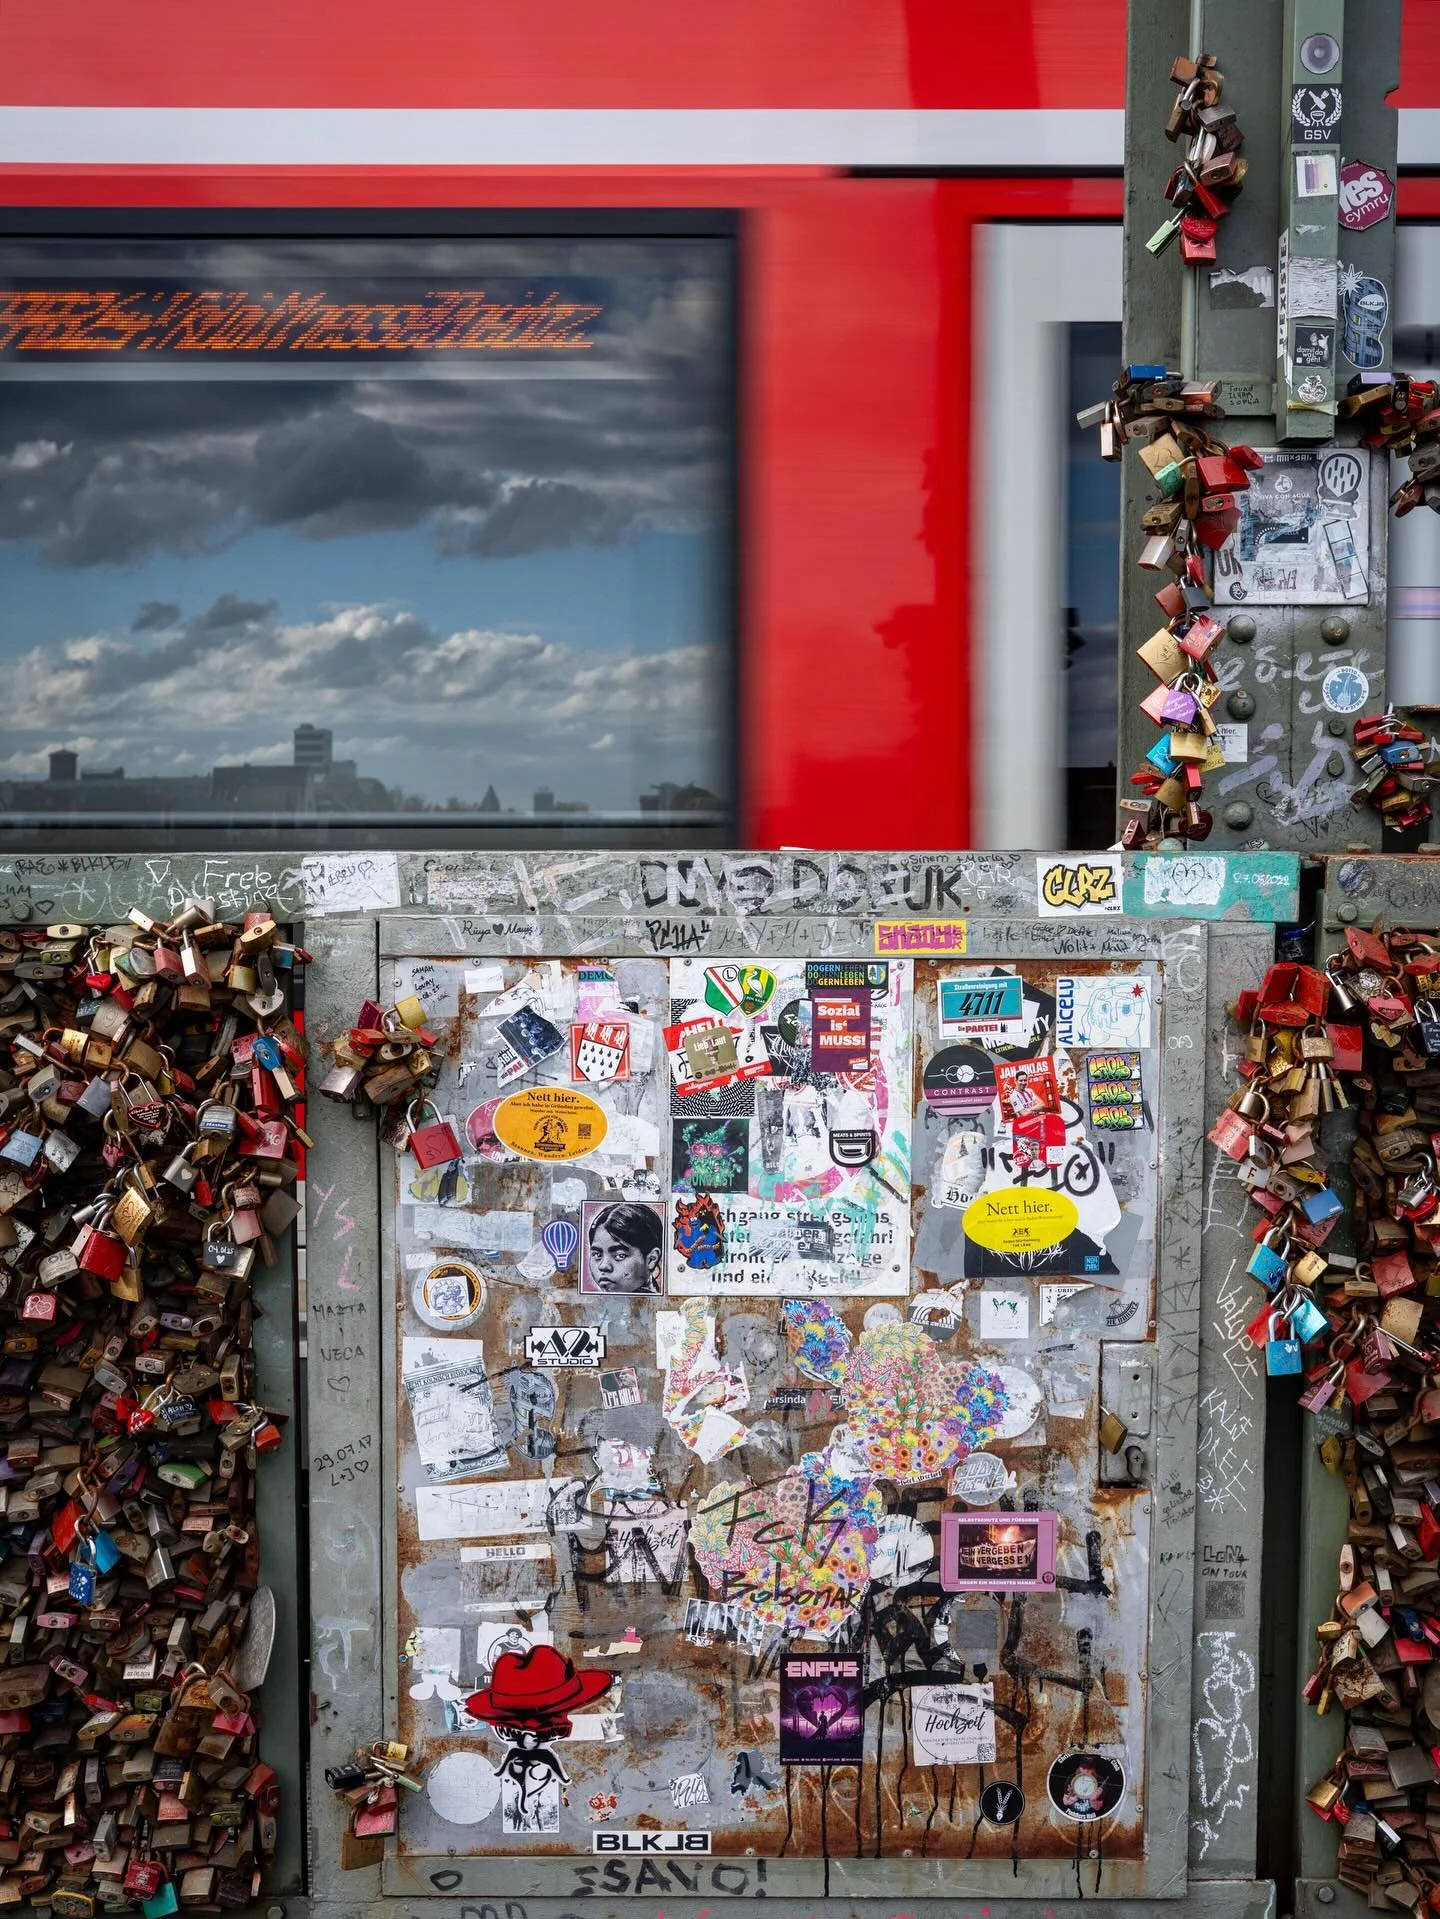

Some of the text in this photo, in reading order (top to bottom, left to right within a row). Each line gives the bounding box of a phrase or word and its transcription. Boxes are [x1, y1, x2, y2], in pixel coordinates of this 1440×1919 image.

[1304, 130, 1332, 140] GSV
[1345, 192, 1390, 224] cymru
[1306, 356, 1321, 364] geht
[908, 853, 949, 865] Sinem
[204, 860, 272, 889] Free
[958, 991, 1005, 1016] 4711
[817, 1004, 861, 1017] Sozial
[965, 1024, 999, 1033] PARTEI
[819, 1034, 866, 1046] MUSS!
[527, 1091, 580, 1104] Nett hier.
[933, 1086, 991, 1097] CONTRAST
[986, 1199, 1053, 1216] Nett hier.
[711, 1268, 744, 1284] und
[537, 1357, 594, 1369] STUDIO
[313, 1434, 372, 1472] 29.07.17
[486, 1546, 526, 1557] HELLO
[976, 1543, 1025, 1556] VERGEBEN
[976, 1554, 1033, 1567] VERGESSEN
[1222, 1568, 1248, 1579] TOUR
[784, 1660, 861, 1678] ENFYS
[924, 1707, 986, 1735] Hochzeit
